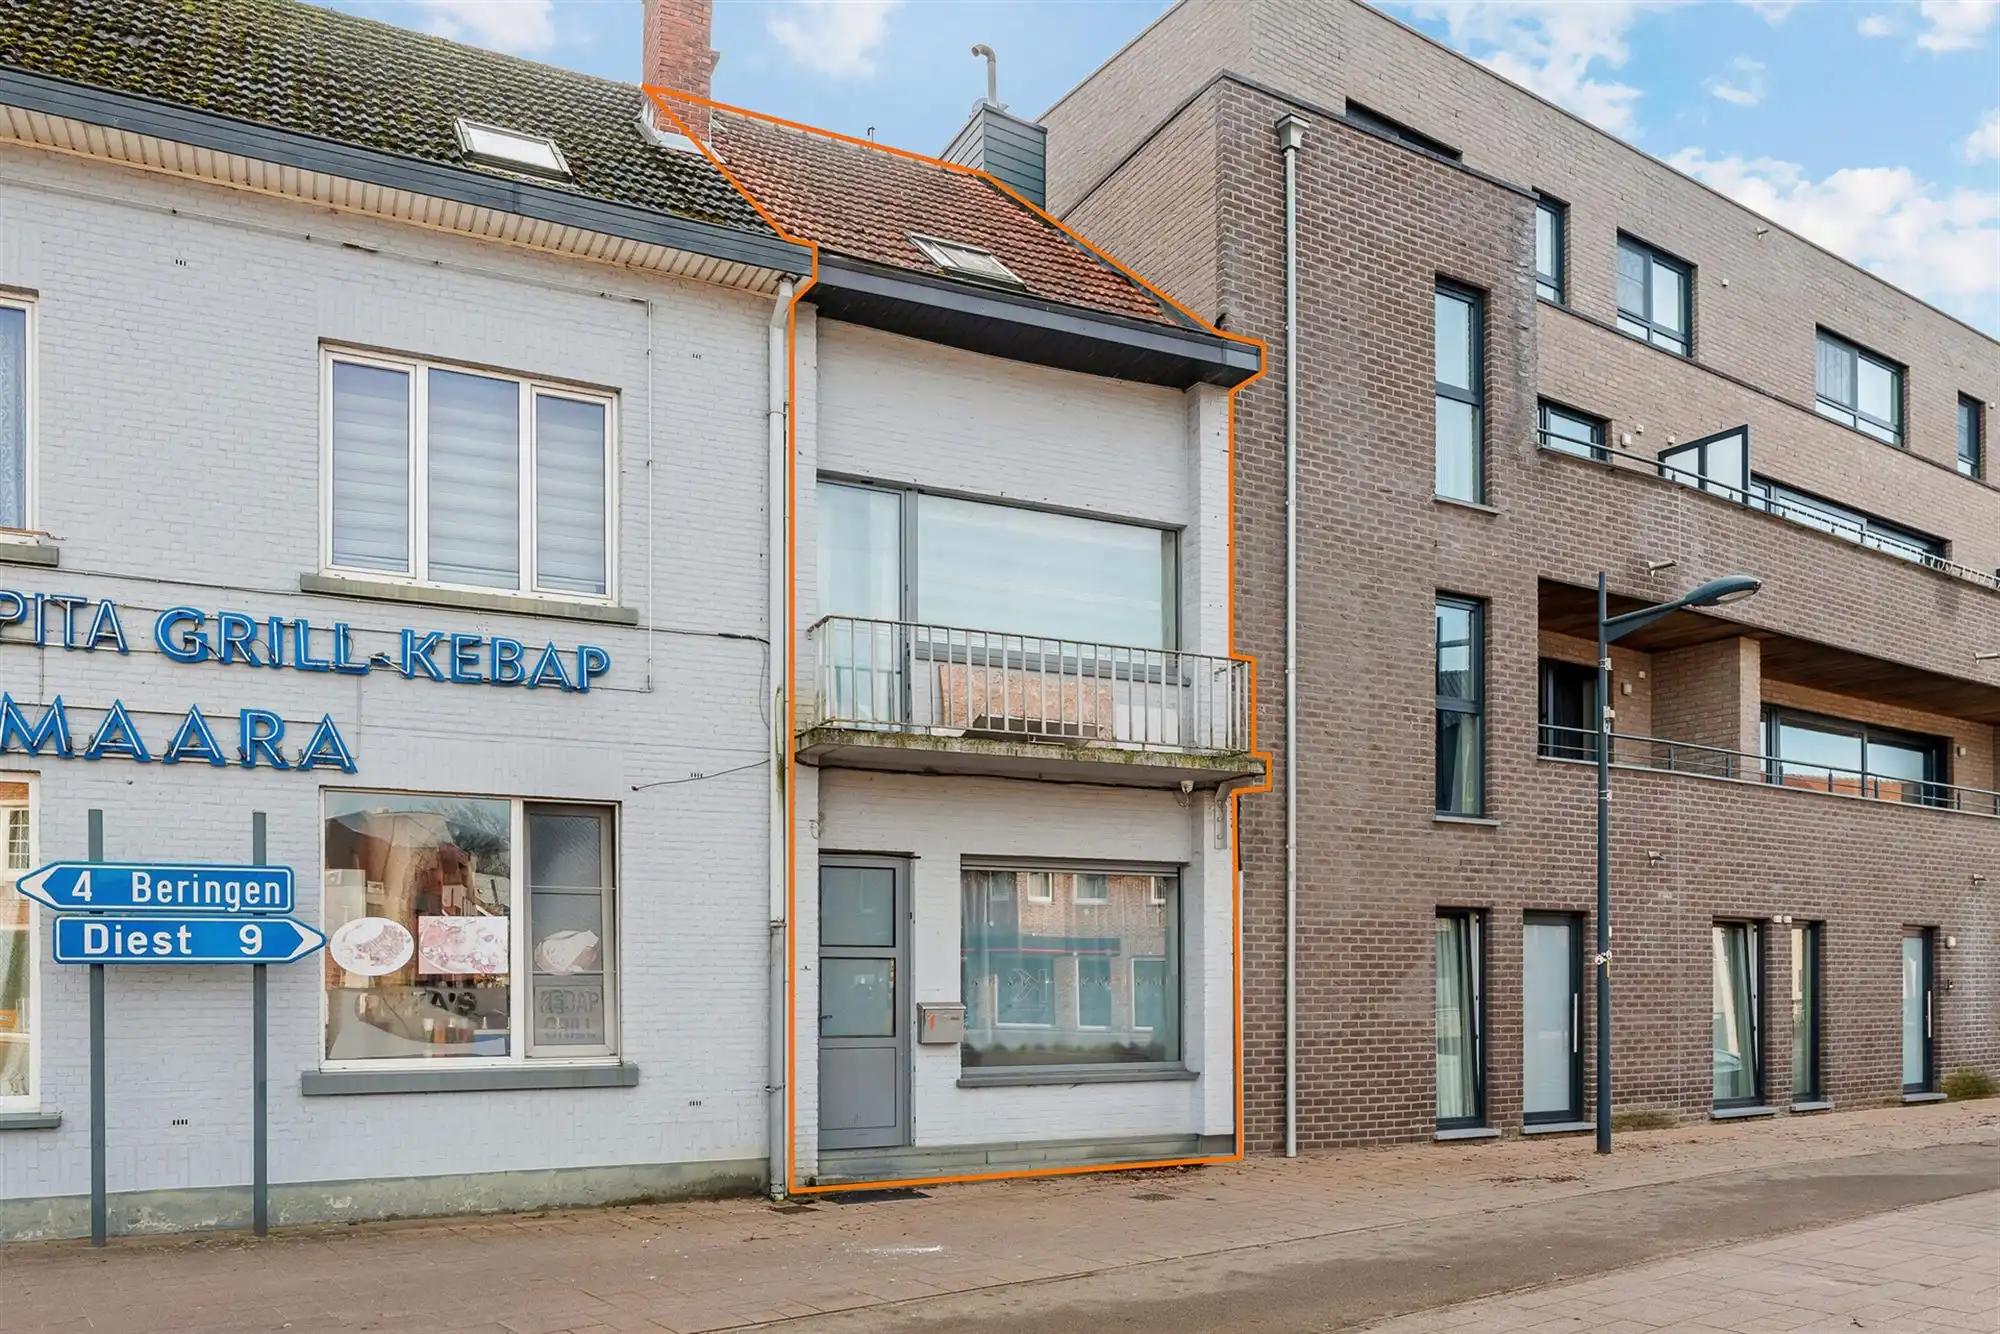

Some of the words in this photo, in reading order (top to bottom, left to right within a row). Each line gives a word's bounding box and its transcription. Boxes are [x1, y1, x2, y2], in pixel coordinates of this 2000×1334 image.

[0, 590, 129, 655] PITA
[0, 691, 358, 774] MAARA
[71, 870, 93, 902] 4
[131, 871, 281, 913] Beringen
[83, 923, 192, 955] Diest
[239, 924, 263, 955] 9
